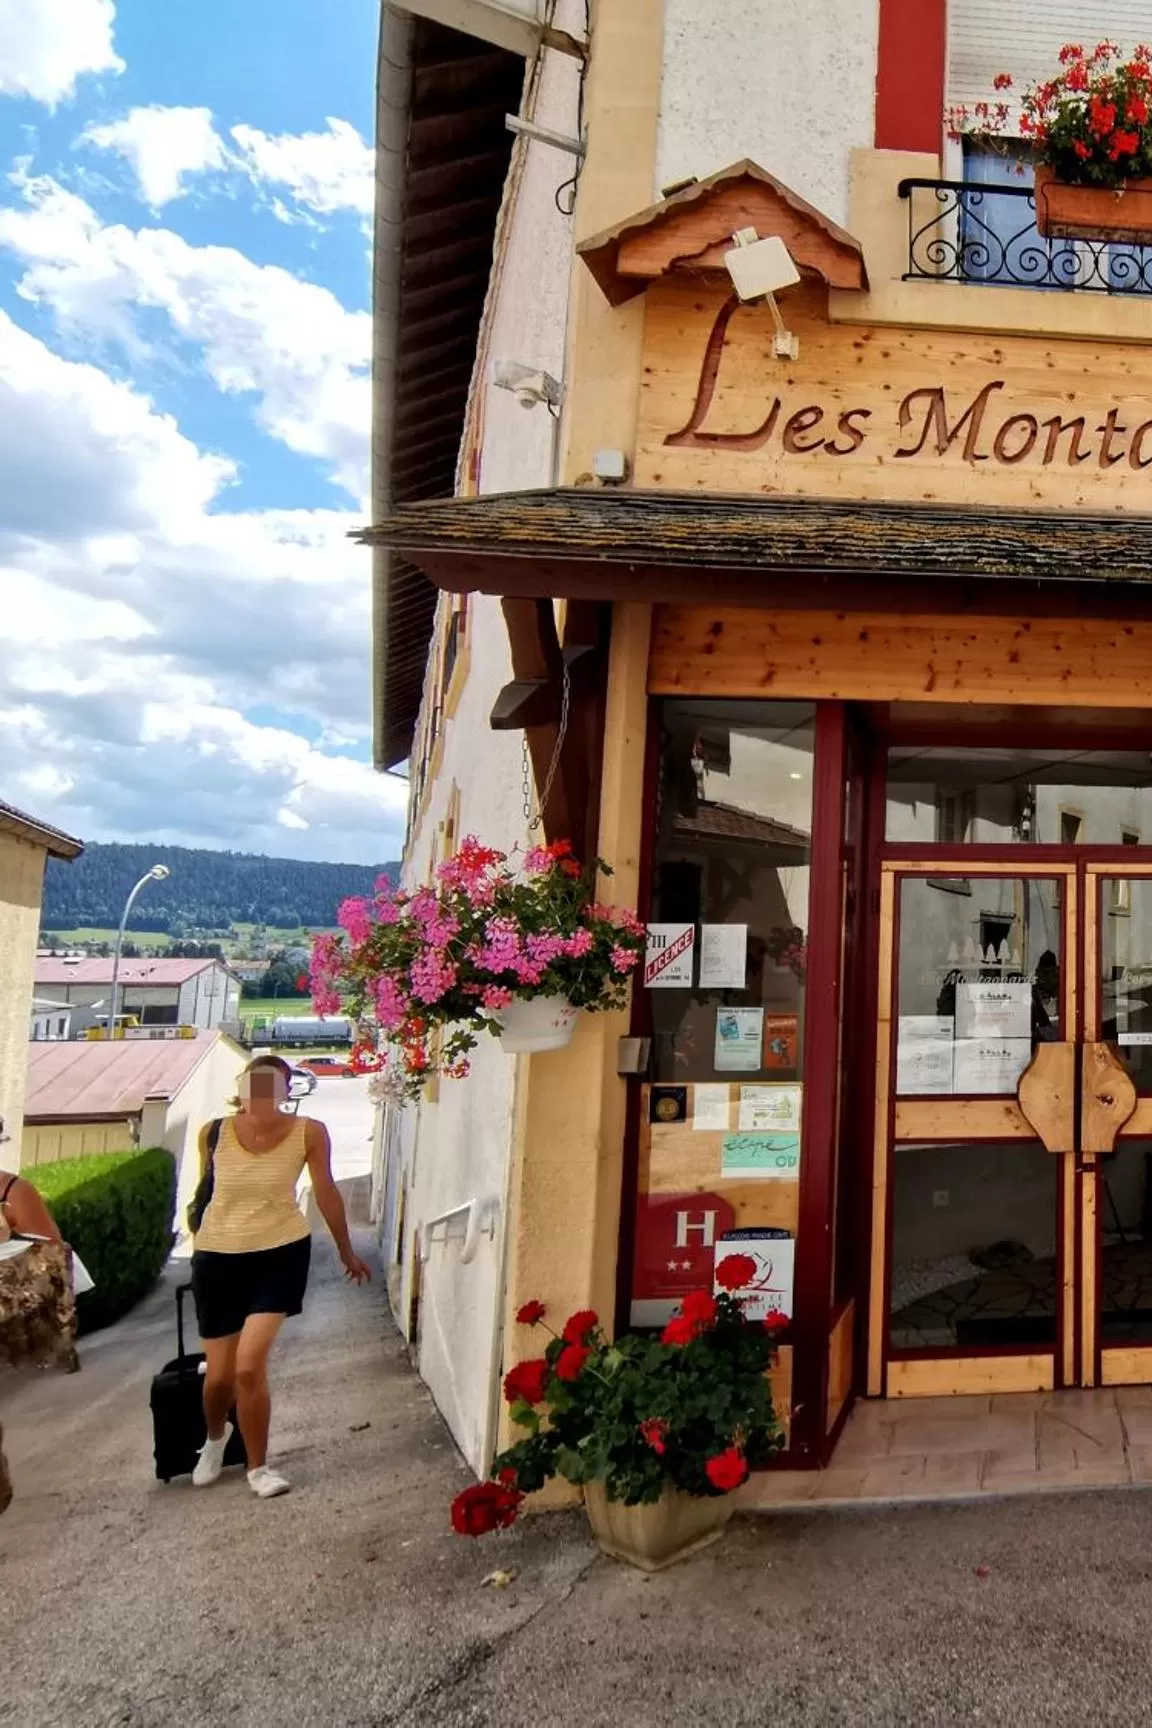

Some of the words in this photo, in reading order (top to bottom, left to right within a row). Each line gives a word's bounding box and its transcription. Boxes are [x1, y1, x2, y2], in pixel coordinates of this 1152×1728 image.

[663, 284, 873, 455] Les
[647, 930, 693, 983] LICENCE
[673, 1209, 719, 1248] H
